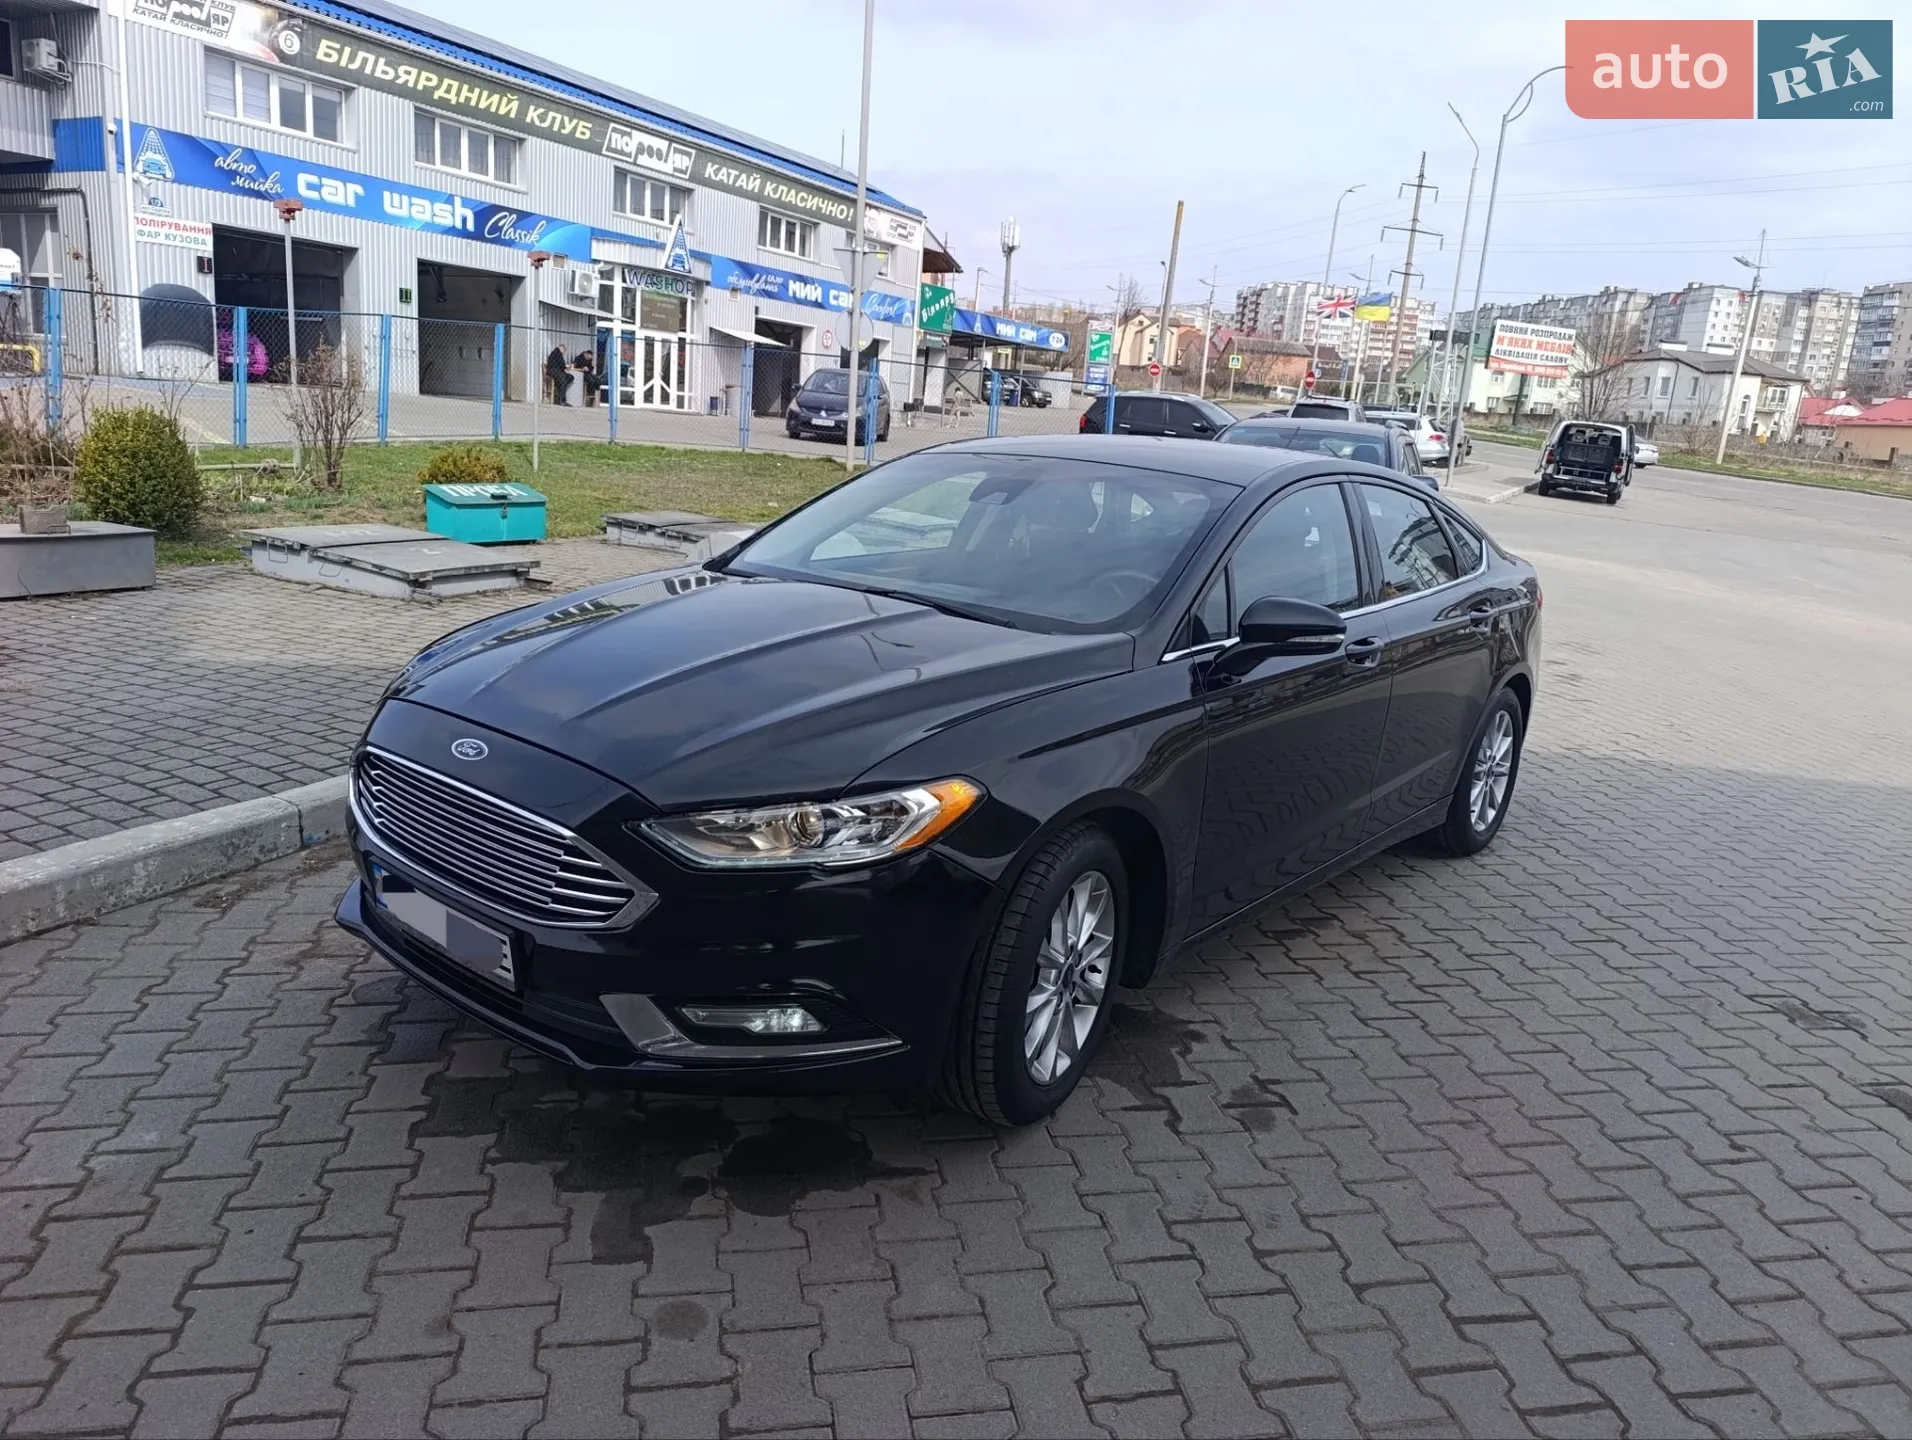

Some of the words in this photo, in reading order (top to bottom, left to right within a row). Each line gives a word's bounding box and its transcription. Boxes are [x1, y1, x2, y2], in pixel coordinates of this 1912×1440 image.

[316, 39, 519, 119] БІЛЬЯРДНИЙ
[525, 105, 593, 140] КЛУБ
[214, 148, 257, 174] авто
[231, 171, 285, 194] мийка
[704, 162, 761, 193] КАТАЙ
[764, 181, 854, 222] КЛАСИЧНО!
[297, 172, 365, 208] car
[383, 191, 475, 232] wash
[137, 229, 161, 239] ФАР
[165, 232, 207, 246] КУЗОВА
[484, 211, 547, 246] Classik
[624, 268, 695, 298] WASHOP
[788, 280, 823, 303] МИЙ
